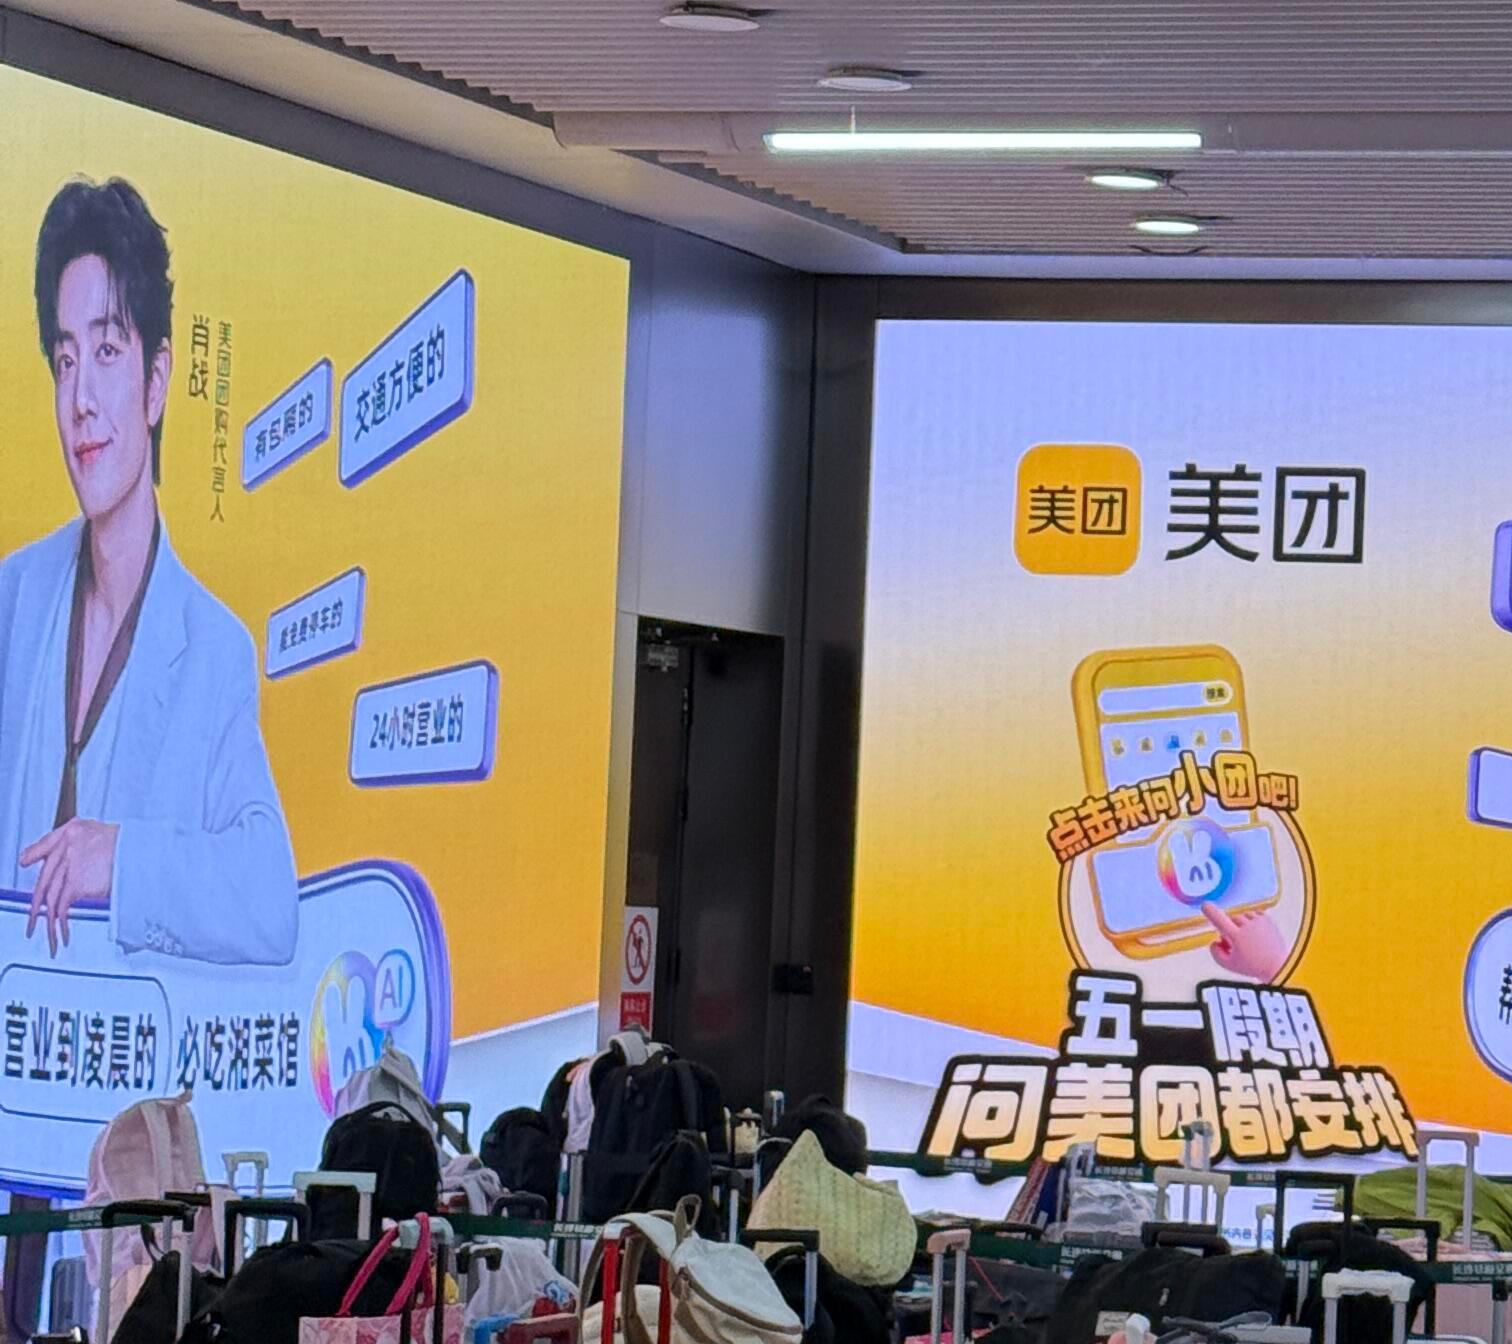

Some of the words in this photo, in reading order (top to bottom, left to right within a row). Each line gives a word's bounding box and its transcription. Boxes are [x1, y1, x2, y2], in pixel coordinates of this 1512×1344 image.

[189, 314, 210, 401] 肖战
[354, 323, 446, 443] 交通方便的
[210, 320, 232, 524] 美团团购代言人
[1028, 484, 1127, 535] 美团
[1164, 463, 1367, 564] 美团
[370, 694, 464, 750] 24小时营业的
[378, 969, 407, 1010] AI
[1068, 971, 1330, 1069] 五一假期
[3, 999, 157, 1091] 营业到凌晨的
[176, 1013, 302, 1090] 必吃湘菜馆
[927, 1060, 1420, 1163] 问美团都安排
